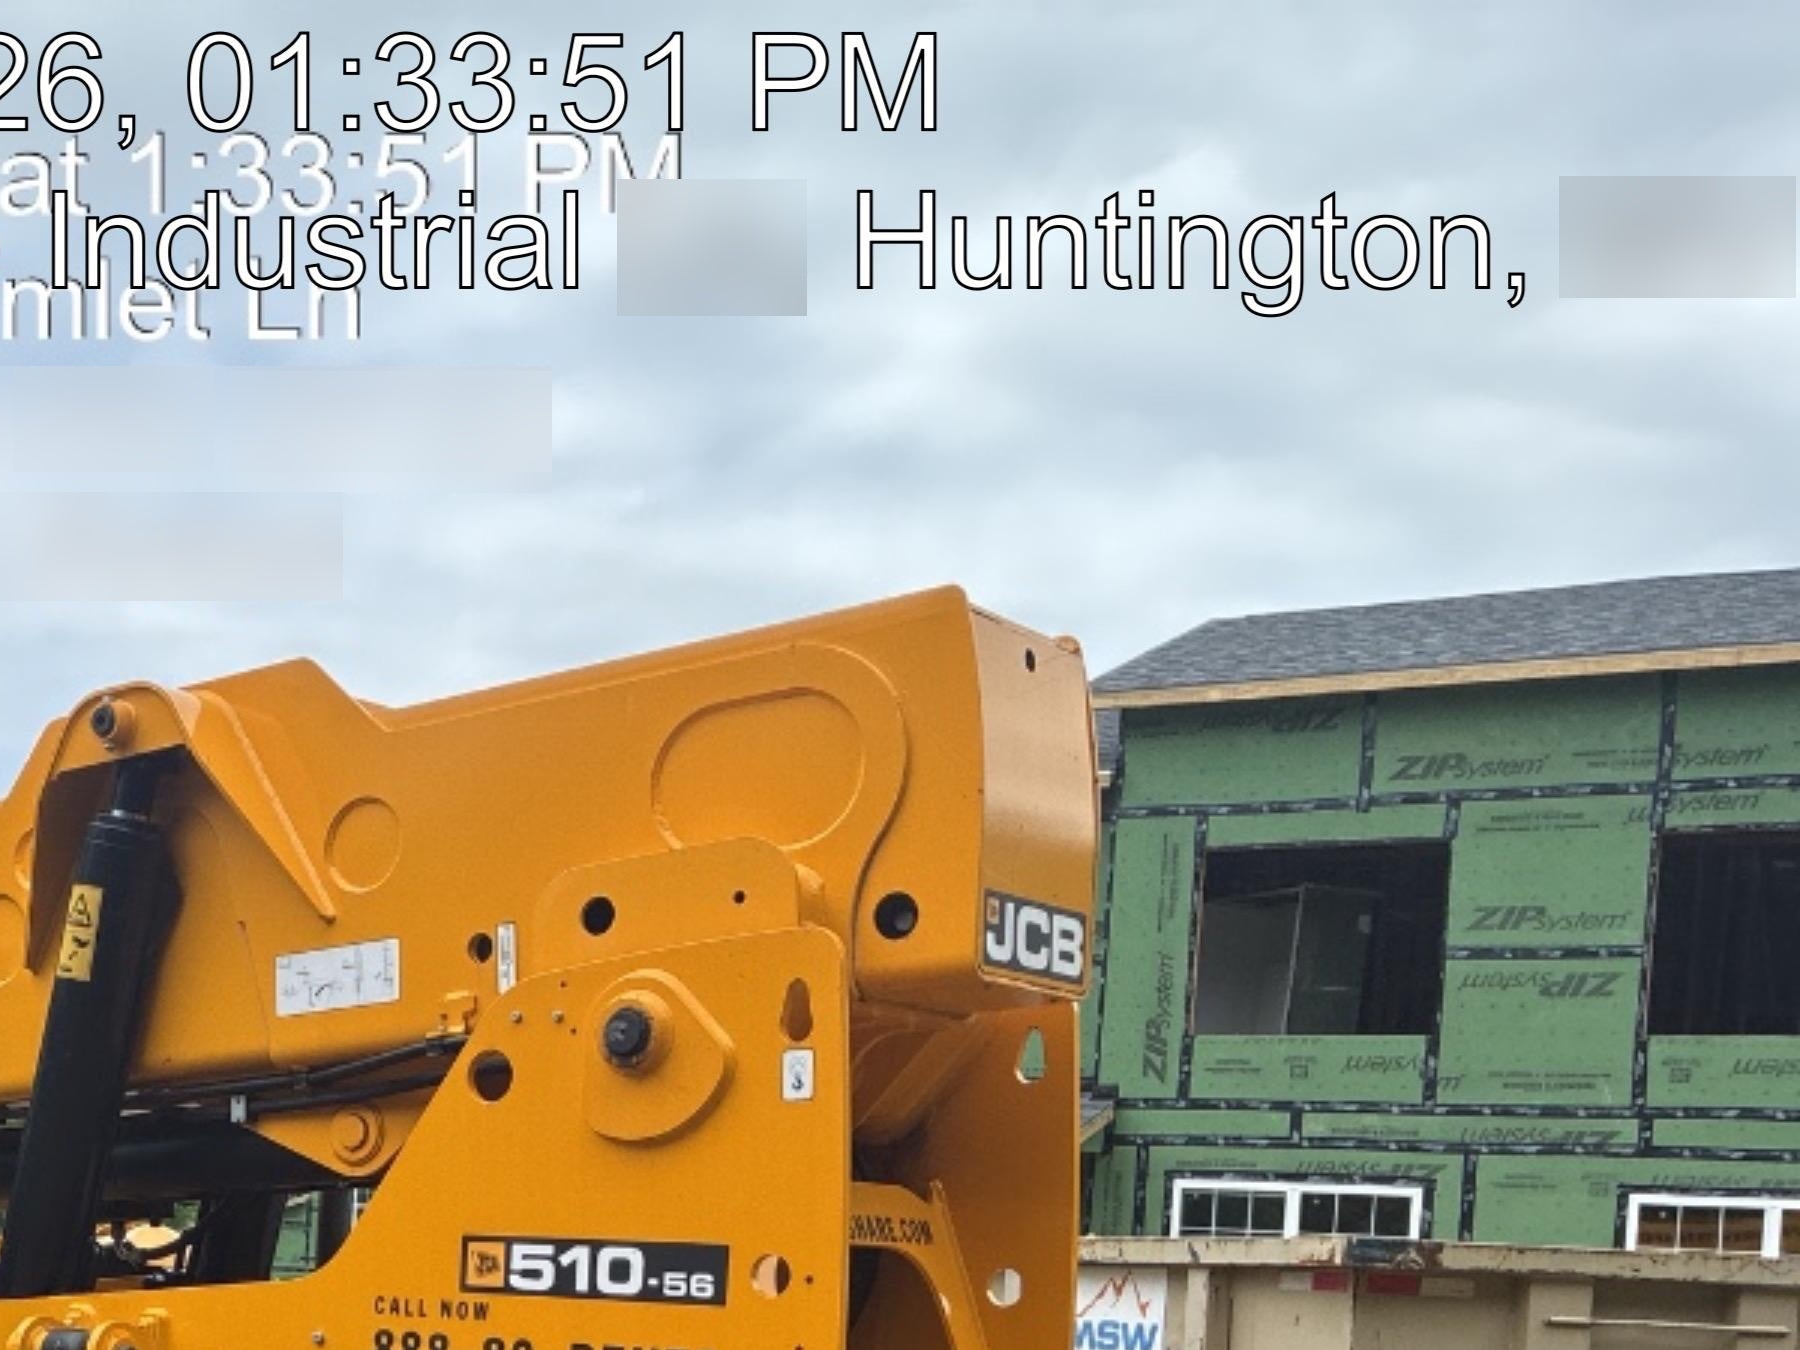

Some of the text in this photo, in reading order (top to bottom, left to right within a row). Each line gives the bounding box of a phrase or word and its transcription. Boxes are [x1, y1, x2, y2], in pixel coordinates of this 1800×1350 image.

[985, 901, 1084, 978] JCB
[375, 1296, 490, 1321] CALL NOW
